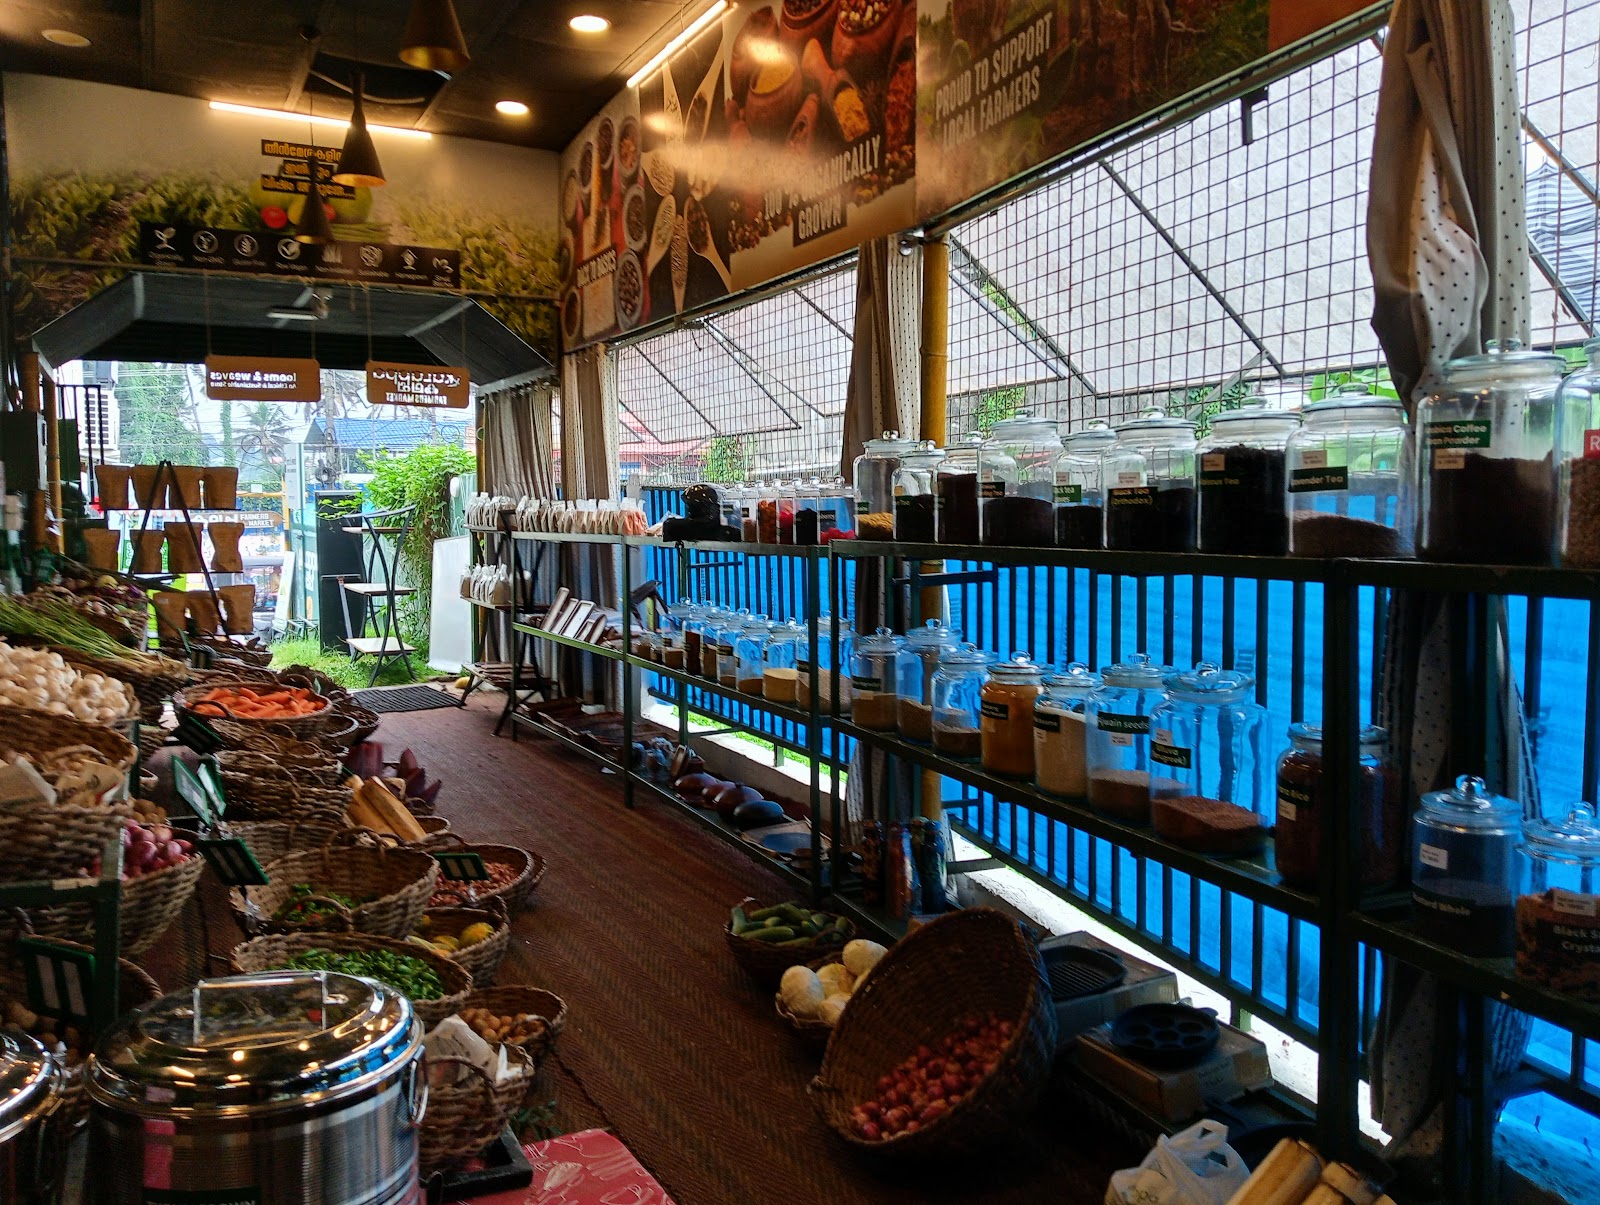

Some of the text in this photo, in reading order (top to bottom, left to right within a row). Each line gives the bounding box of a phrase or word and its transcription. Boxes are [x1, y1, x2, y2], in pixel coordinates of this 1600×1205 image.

[936, 12, 1052, 120] PROUD TO SUPPORT
[943, 65, 1040, 152] LOCAL FARMERS
[799, 192, 841, 240] GROWN
[1453, 424, 1488, 434] Coffee
[1325, 475, 1344, 483] Tea
[239, 513, 269, 521] FARMERS
